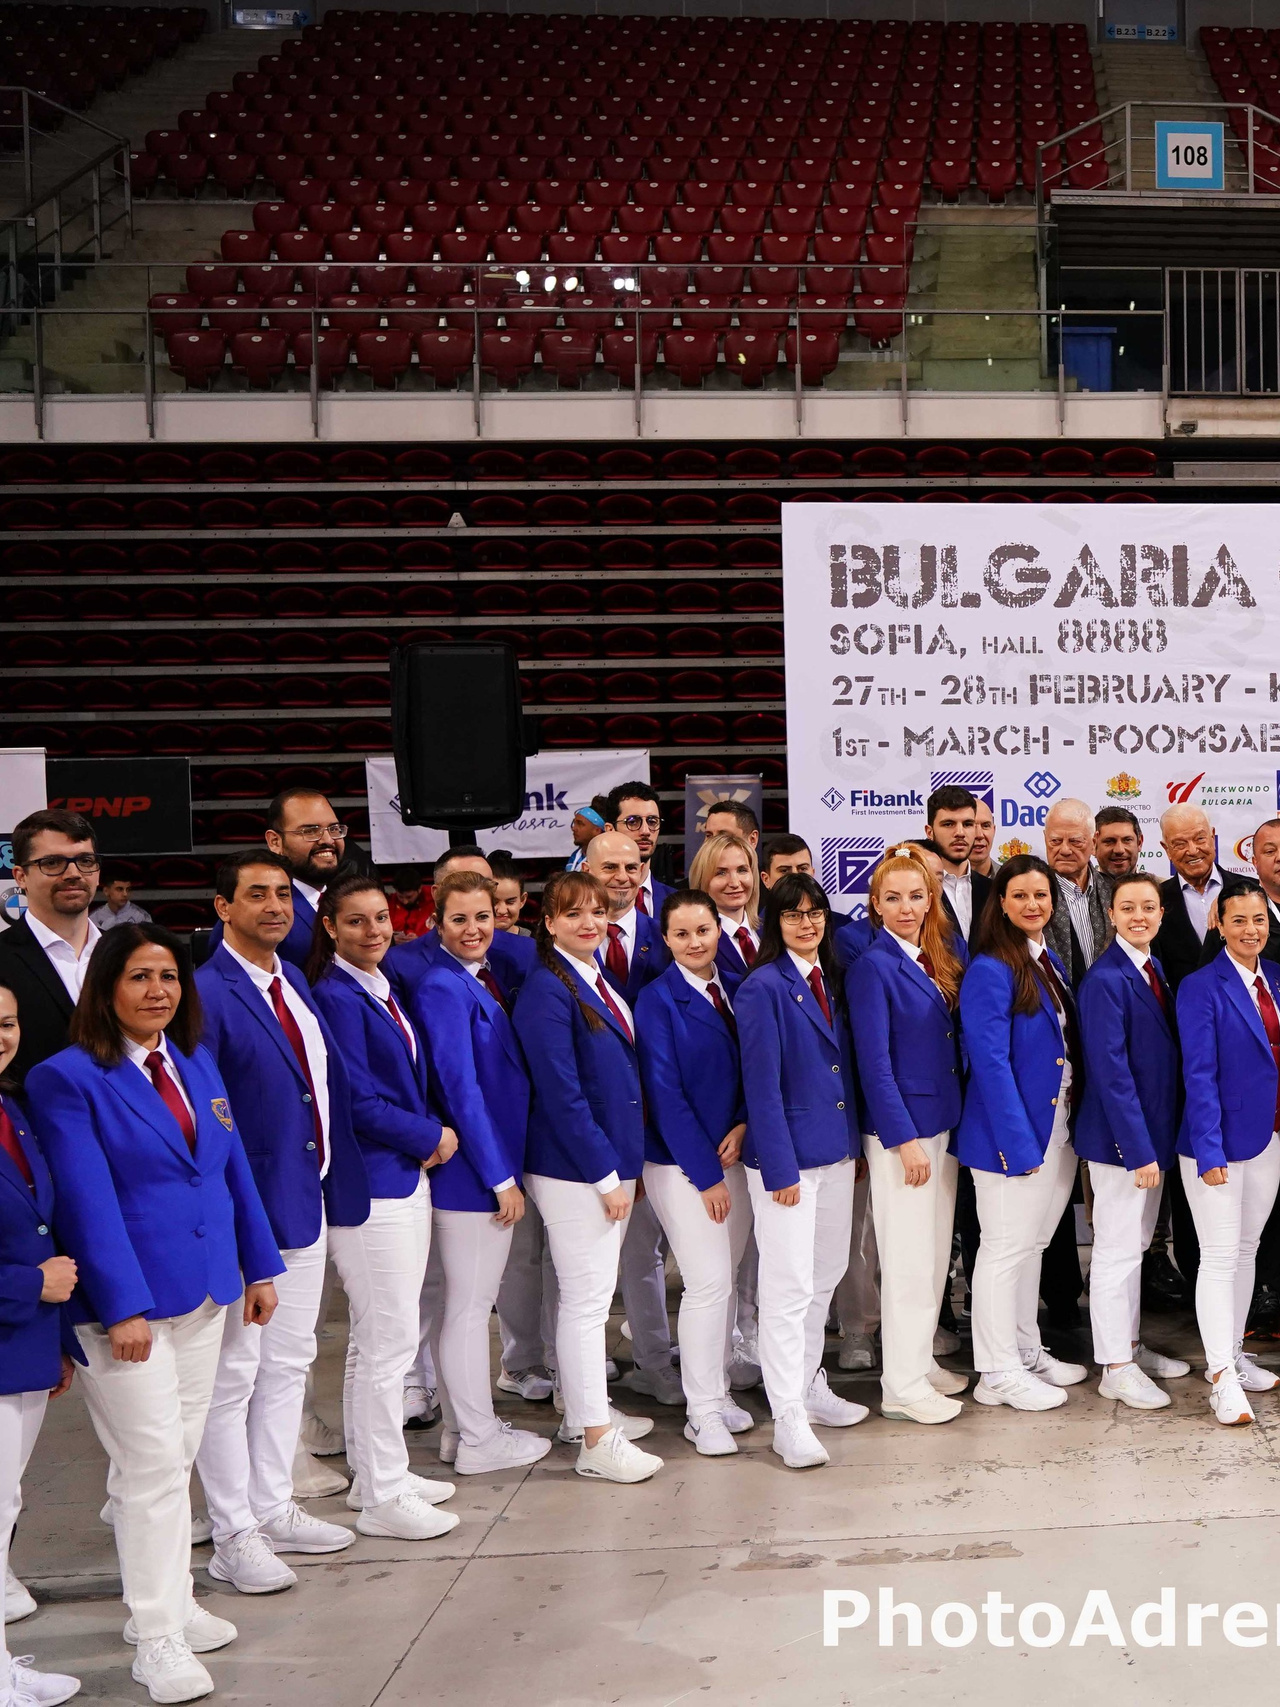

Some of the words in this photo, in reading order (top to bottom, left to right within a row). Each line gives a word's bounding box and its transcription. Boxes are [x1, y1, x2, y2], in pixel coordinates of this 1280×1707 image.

[1116, 28, 1137, 36] B.2.3
[1146, 29, 1167, 37] B.2.2
[1171, 145, 1208, 166] 108
[829, 543, 1257, 609] BULGARIA
[830, 623, 967, 659] SOFIA,
[982, 636, 1043, 654] HALL
[1057, 618, 1168, 653] 8888
[940, 674, 1017, 705] 28TH
[1030, 673, 1231, 705] FEBRUARY
[903, 724, 1050, 757] MARCH
[850, 790, 924, 807] Fibank
[1201, 785, 1270, 793] TAEKWONDO
[1201, 798, 1253, 806] BULGARIA
